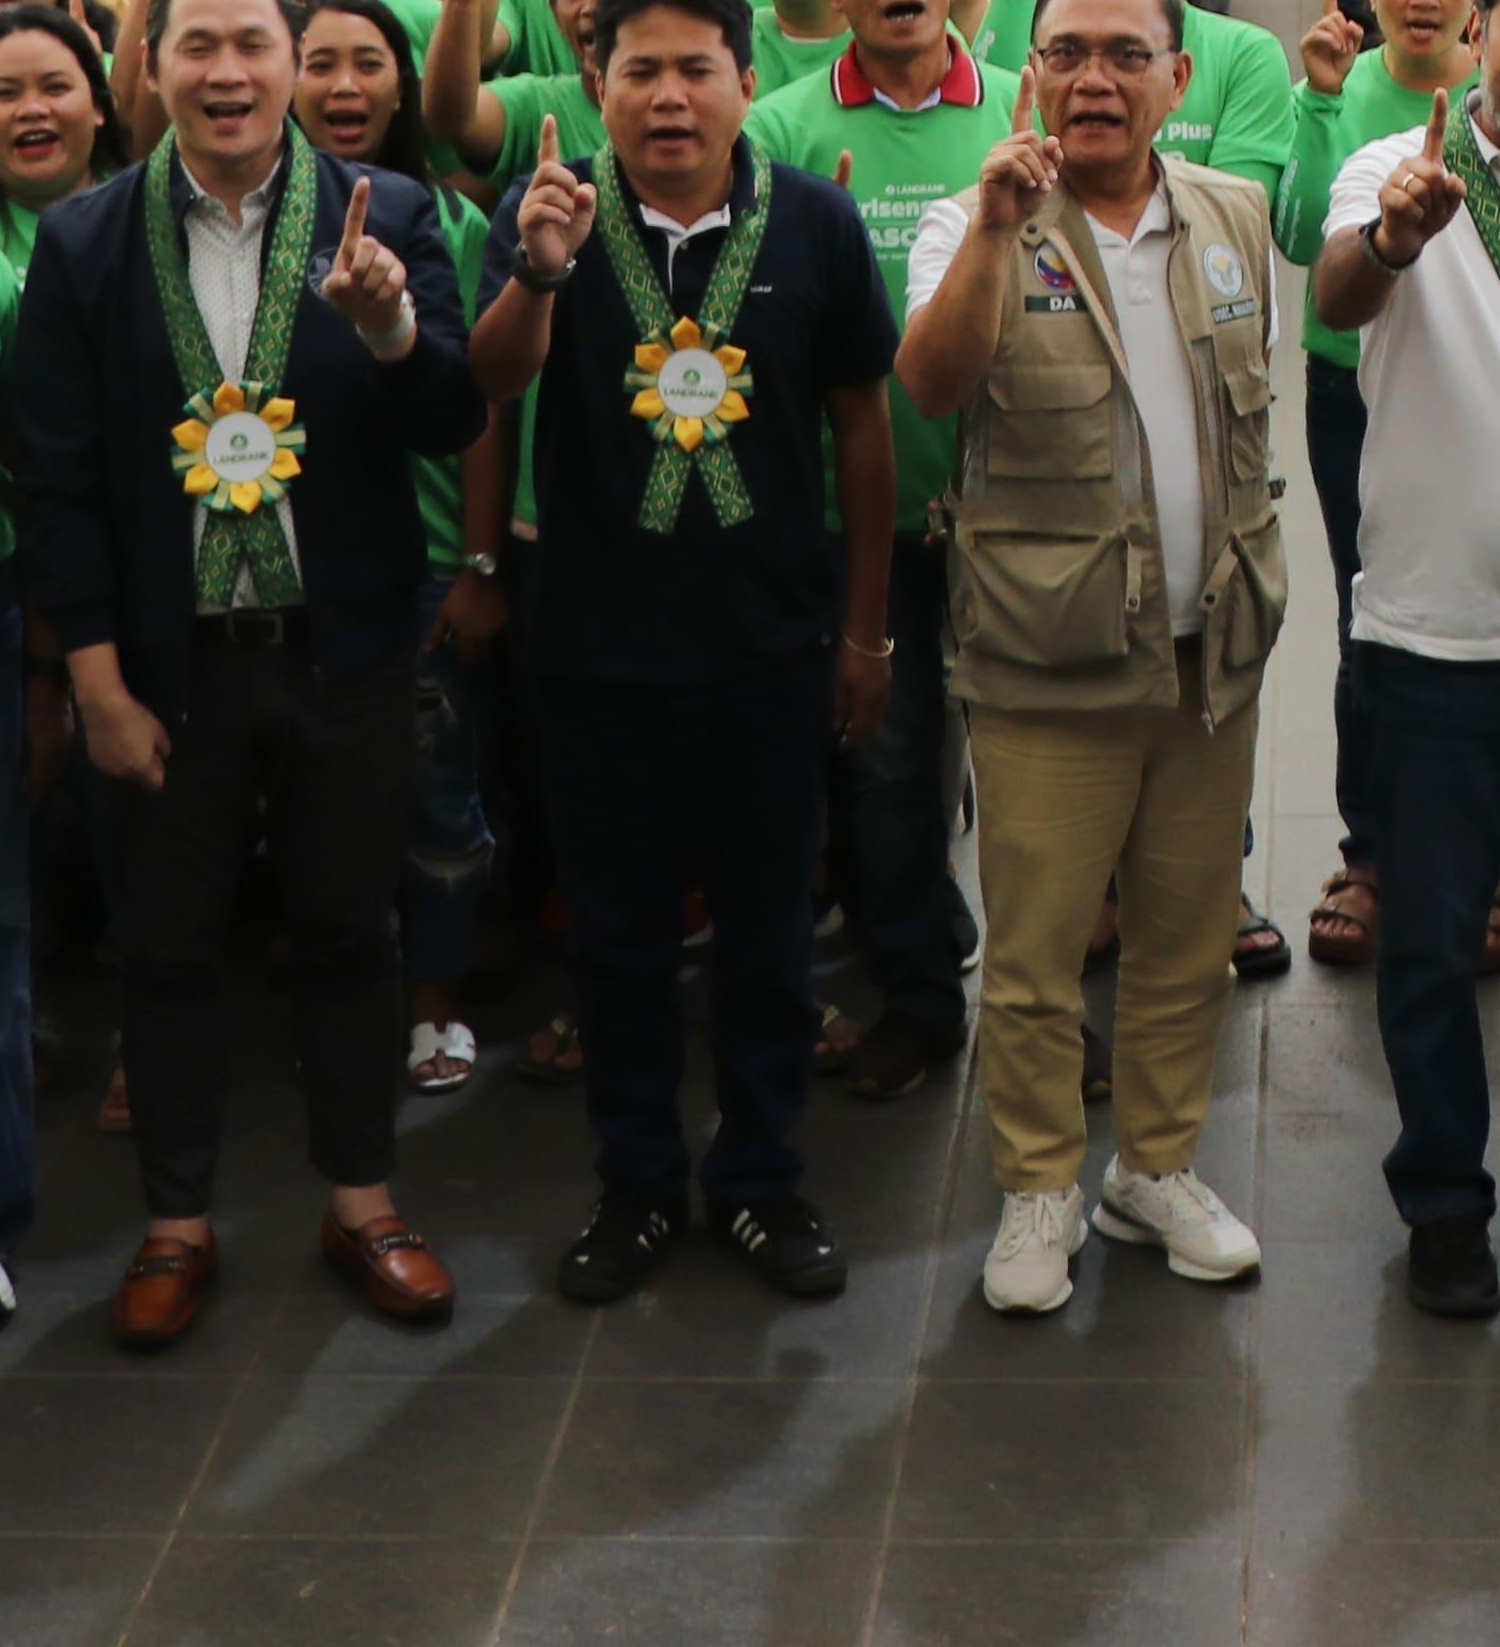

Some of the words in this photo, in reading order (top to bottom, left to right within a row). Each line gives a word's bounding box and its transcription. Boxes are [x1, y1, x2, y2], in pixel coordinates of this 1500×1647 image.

[1168, 121, 1213, 141] Plus
[1049, 296, 1077, 311] DA
[212, 450, 269, 465] LANDBANK
